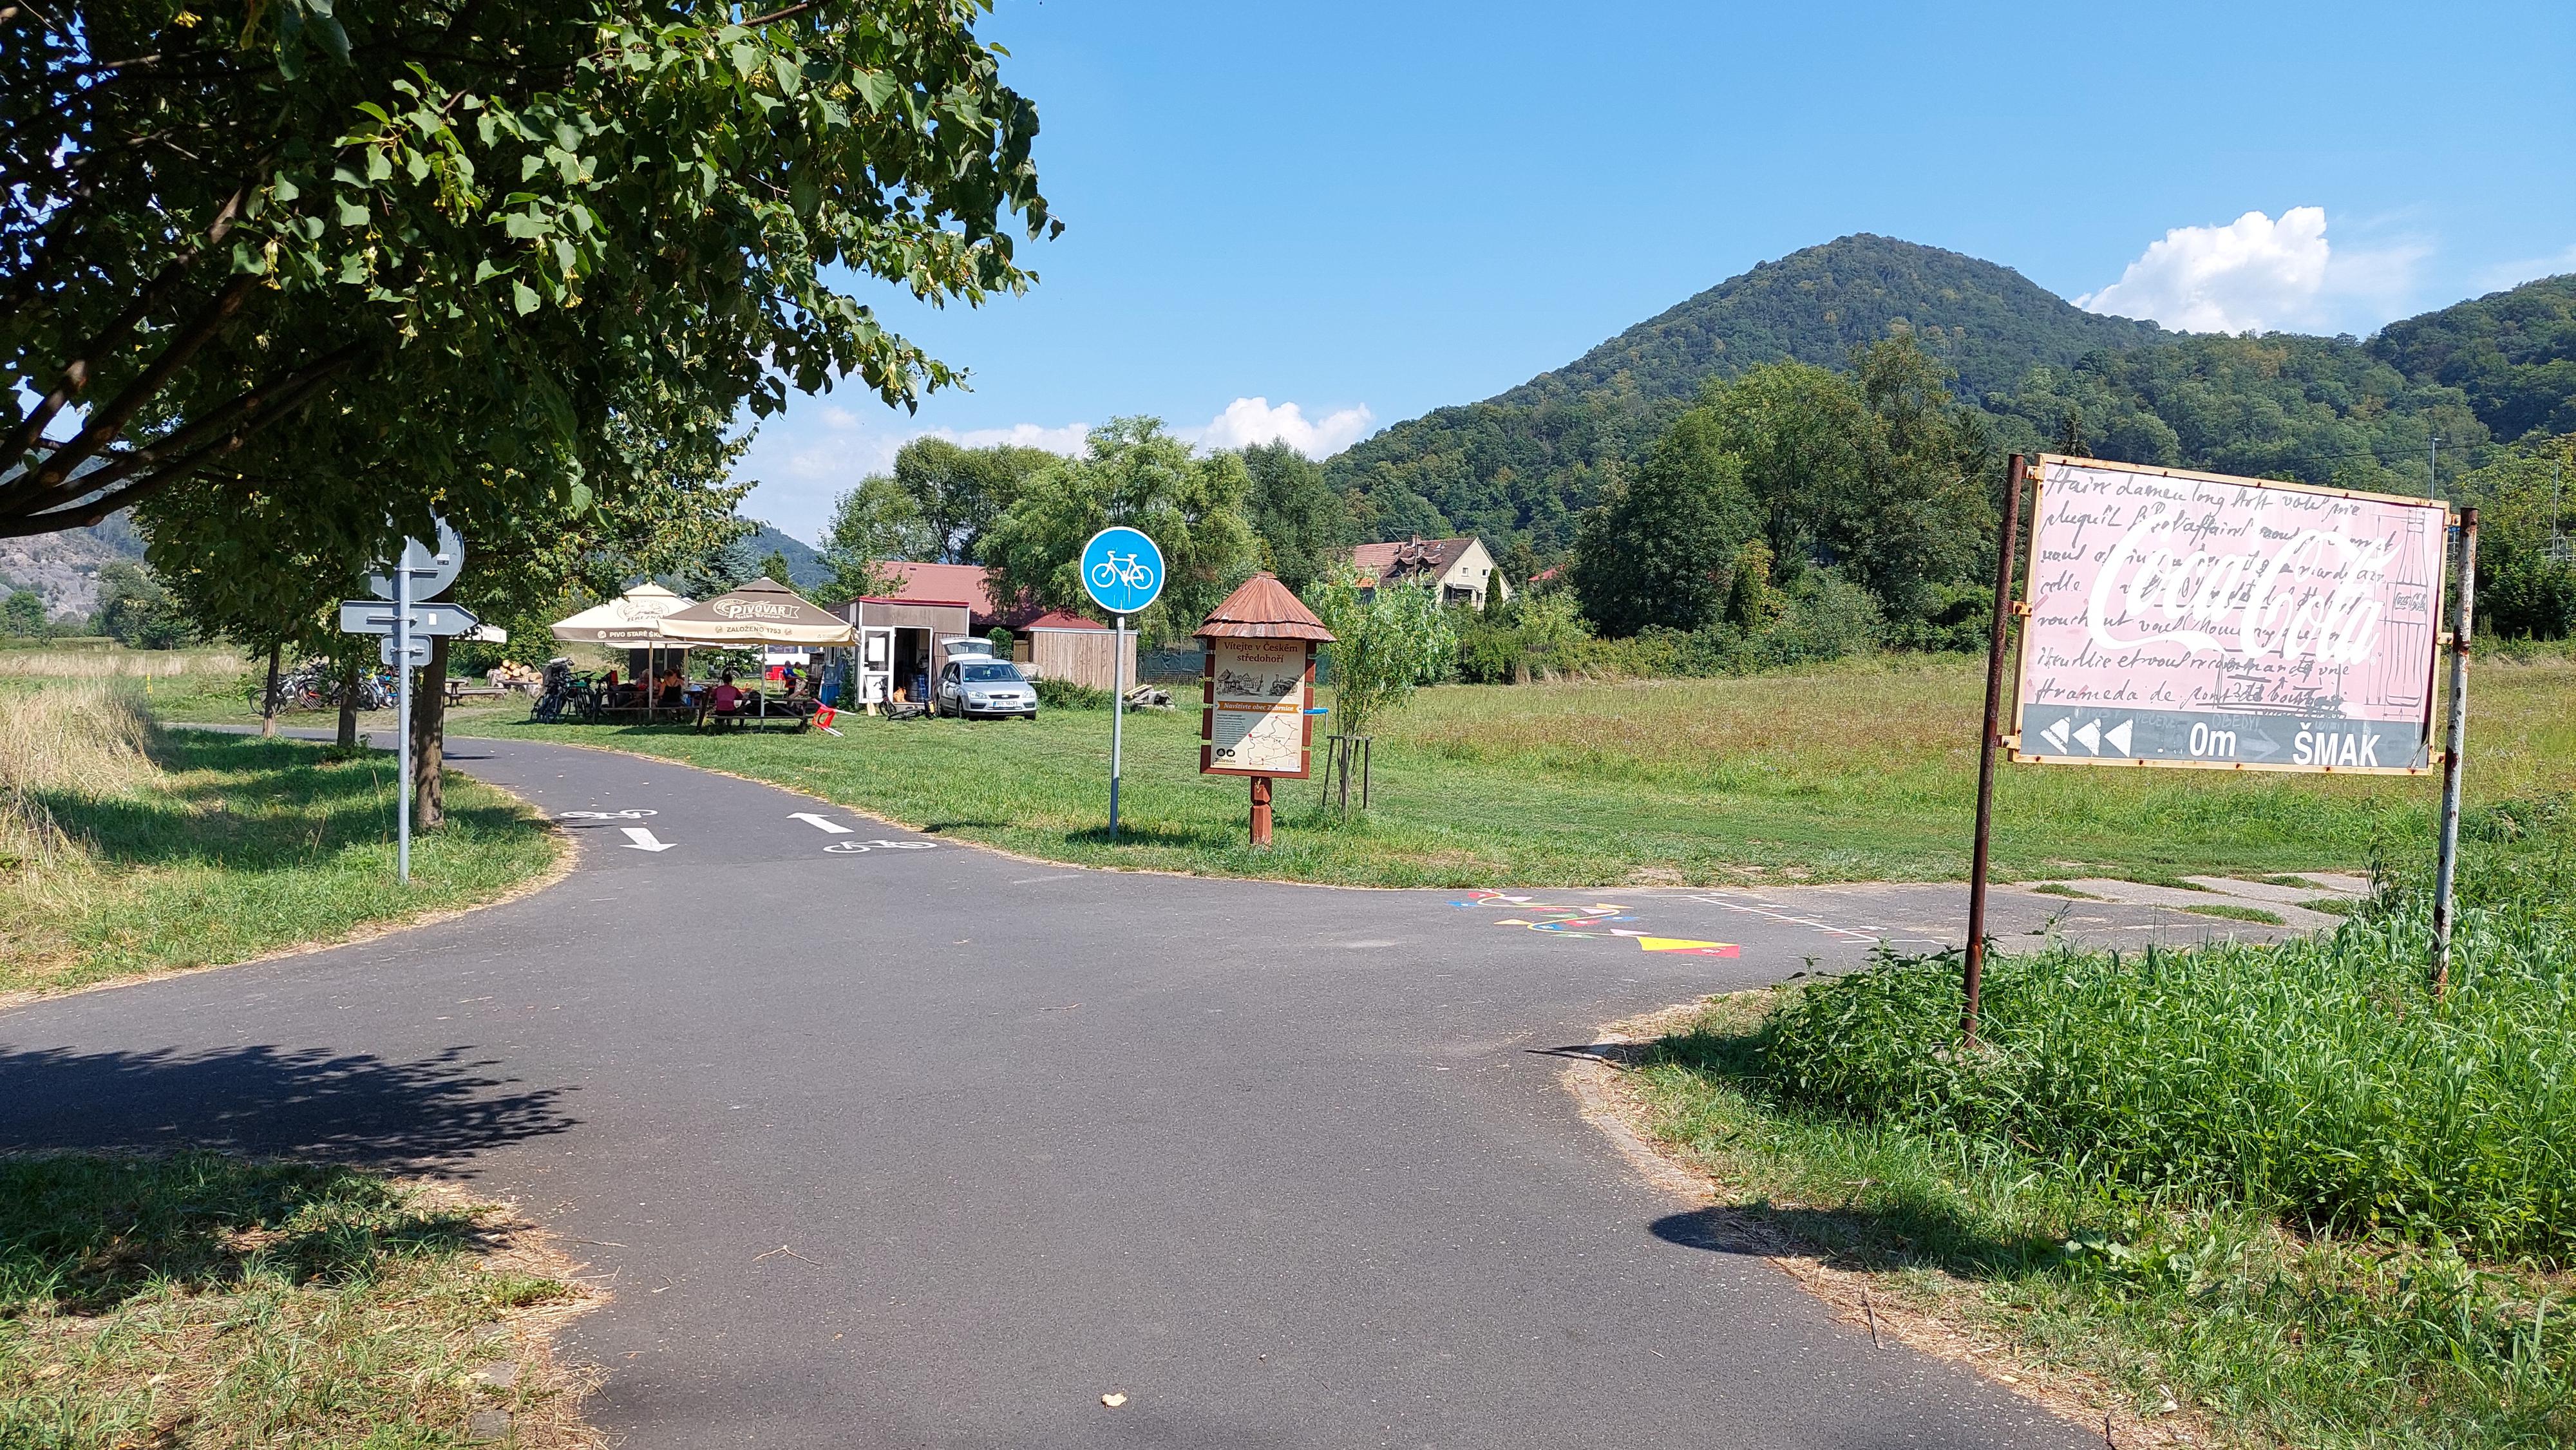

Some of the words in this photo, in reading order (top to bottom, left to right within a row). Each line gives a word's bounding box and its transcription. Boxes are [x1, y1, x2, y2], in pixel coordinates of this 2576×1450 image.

[728, 605, 786, 618] PIVOVAR
[1224, 642, 1253, 652] Vítejte
[1263, 641, 1298, 652] Českém
[1236, 654, 1283, 663] středohoří
[2189, 722, 2237, 757] 0m
[2293, 722, 2381, 767] ŠMAK
